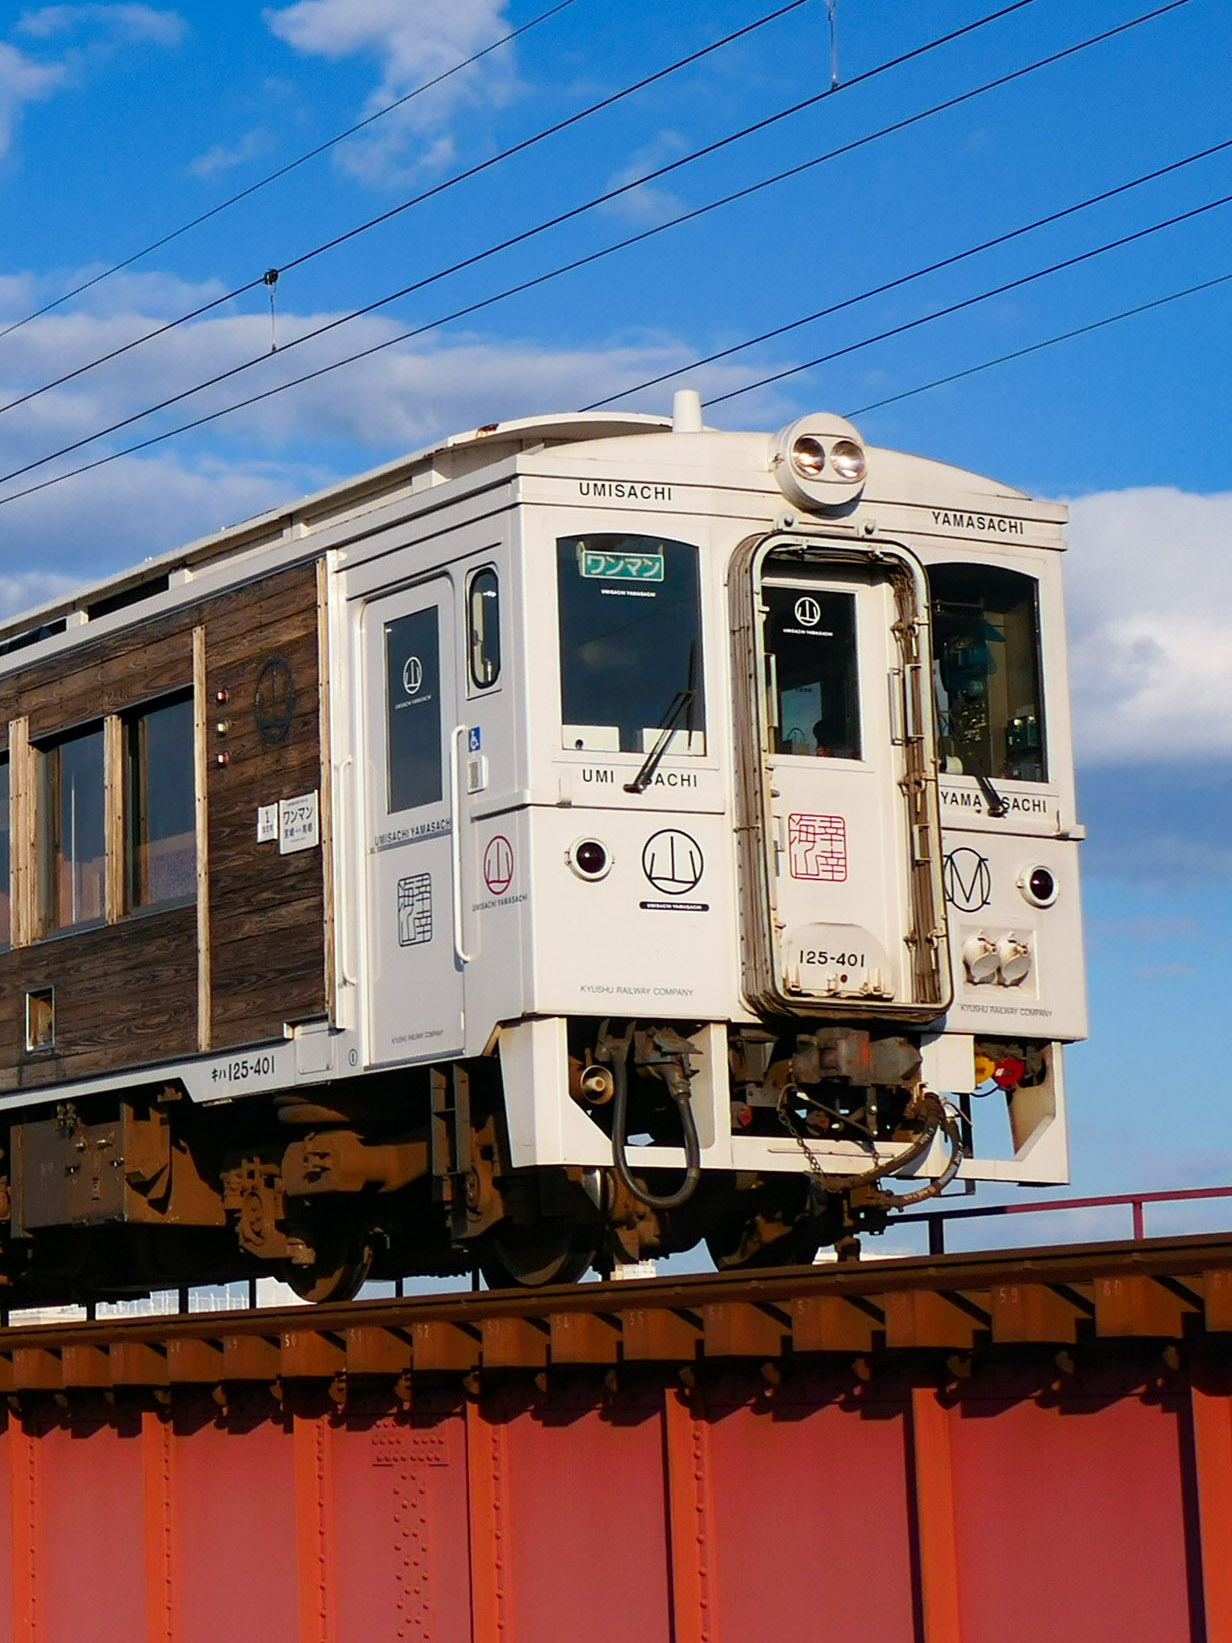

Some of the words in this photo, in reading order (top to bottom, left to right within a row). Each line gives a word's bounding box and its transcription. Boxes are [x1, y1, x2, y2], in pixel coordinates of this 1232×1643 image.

[579, 482, 672, 501] UMISACHI
[931, 510, 1024, 535] YAMASACHI
[587, 555, 661, 577] ワンマン
[283, 807, 313, 826] ワンマン
[799, 950, 865, 968] 125-401
[580, 985, 614, 994] KYUSHU
[616, 986, 650, 995] RAILWAY
[653, 988, 694, 997] COMPANY
[416, 1324, 430, 1339] 52
